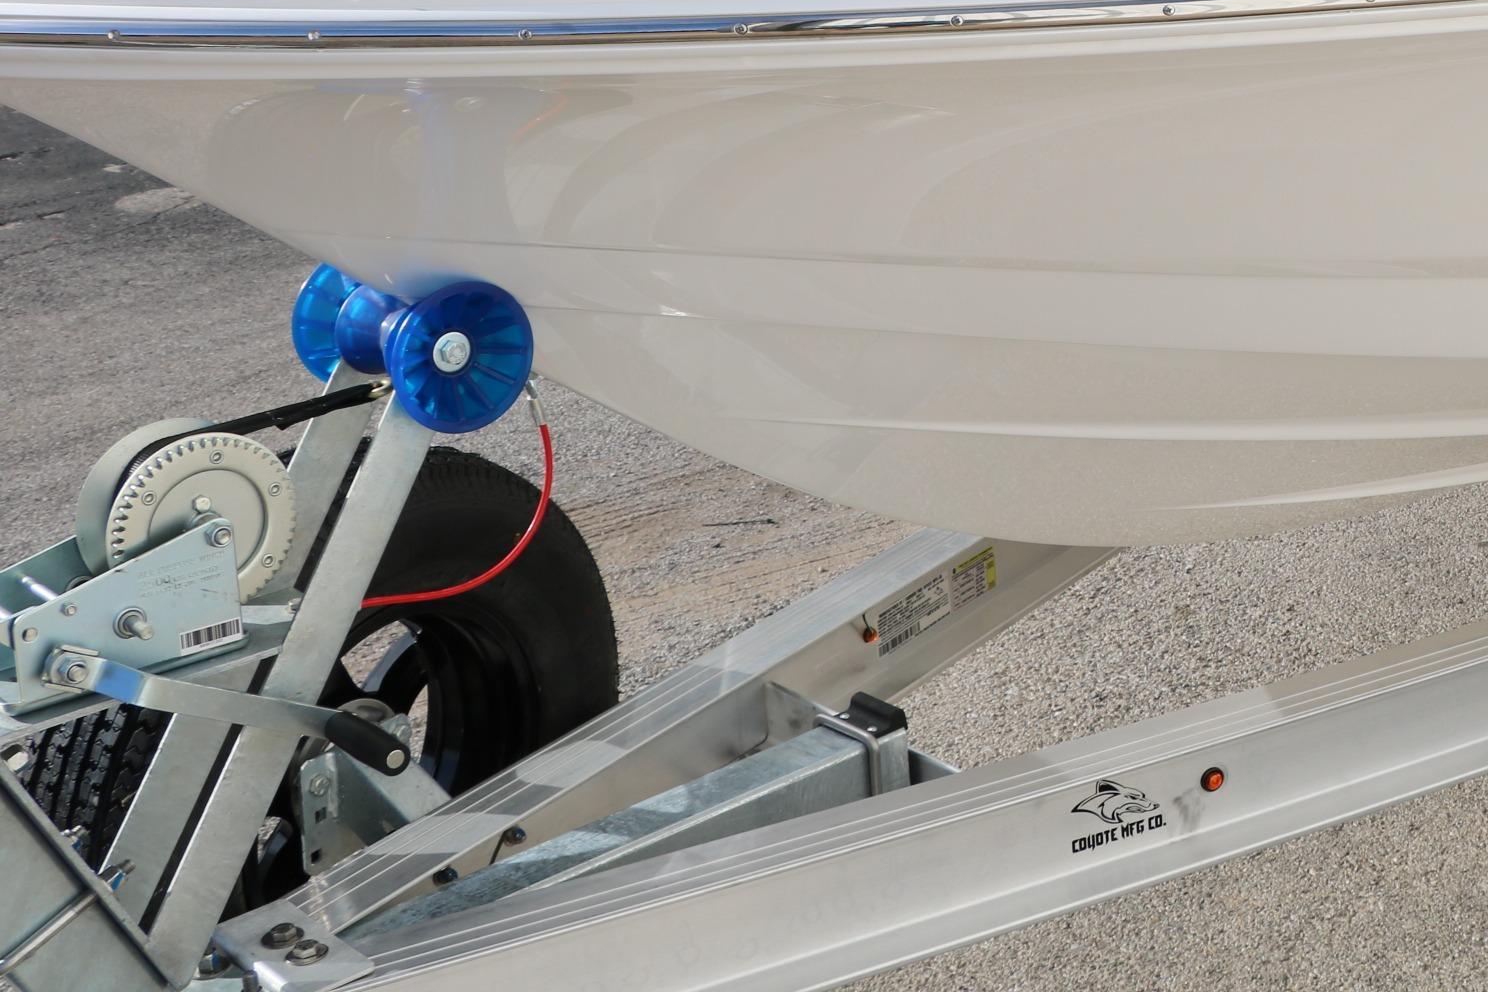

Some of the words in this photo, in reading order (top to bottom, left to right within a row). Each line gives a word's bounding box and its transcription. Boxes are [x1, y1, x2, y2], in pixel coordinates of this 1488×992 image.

[1071, 827, 1119, 854] COYOTE
[1121, 819, 1145, 840] MFG
[1148, 814, 1167, 831] CO.
